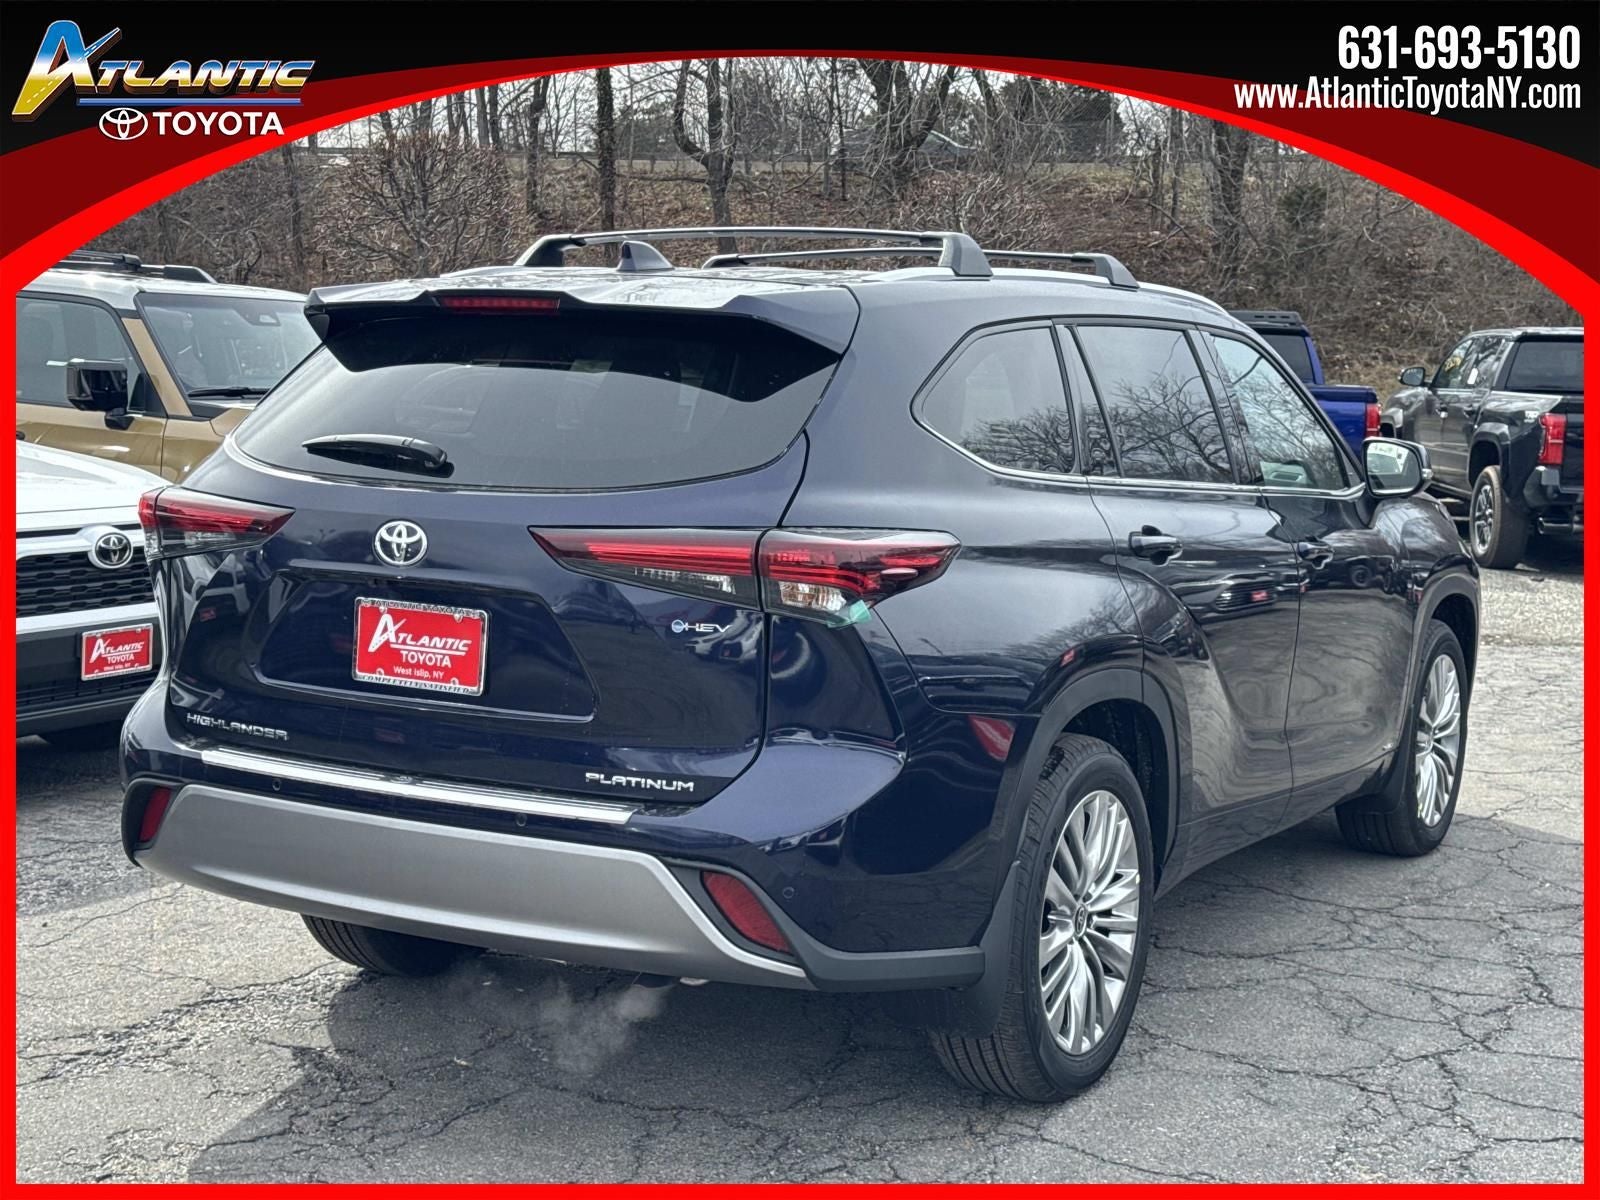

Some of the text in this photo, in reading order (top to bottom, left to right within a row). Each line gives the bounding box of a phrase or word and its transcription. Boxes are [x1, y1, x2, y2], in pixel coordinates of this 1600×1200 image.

[107, 653, 135, 665] TOYOTA
[400, 650, 452, 668] TOYOTA
[393, 665, 412, 676] West
[433, 670, 445, 680] NY
[186, 712, 290, 741] HIGHLANDER
[585, 772, 695, 792] PLATINUM
